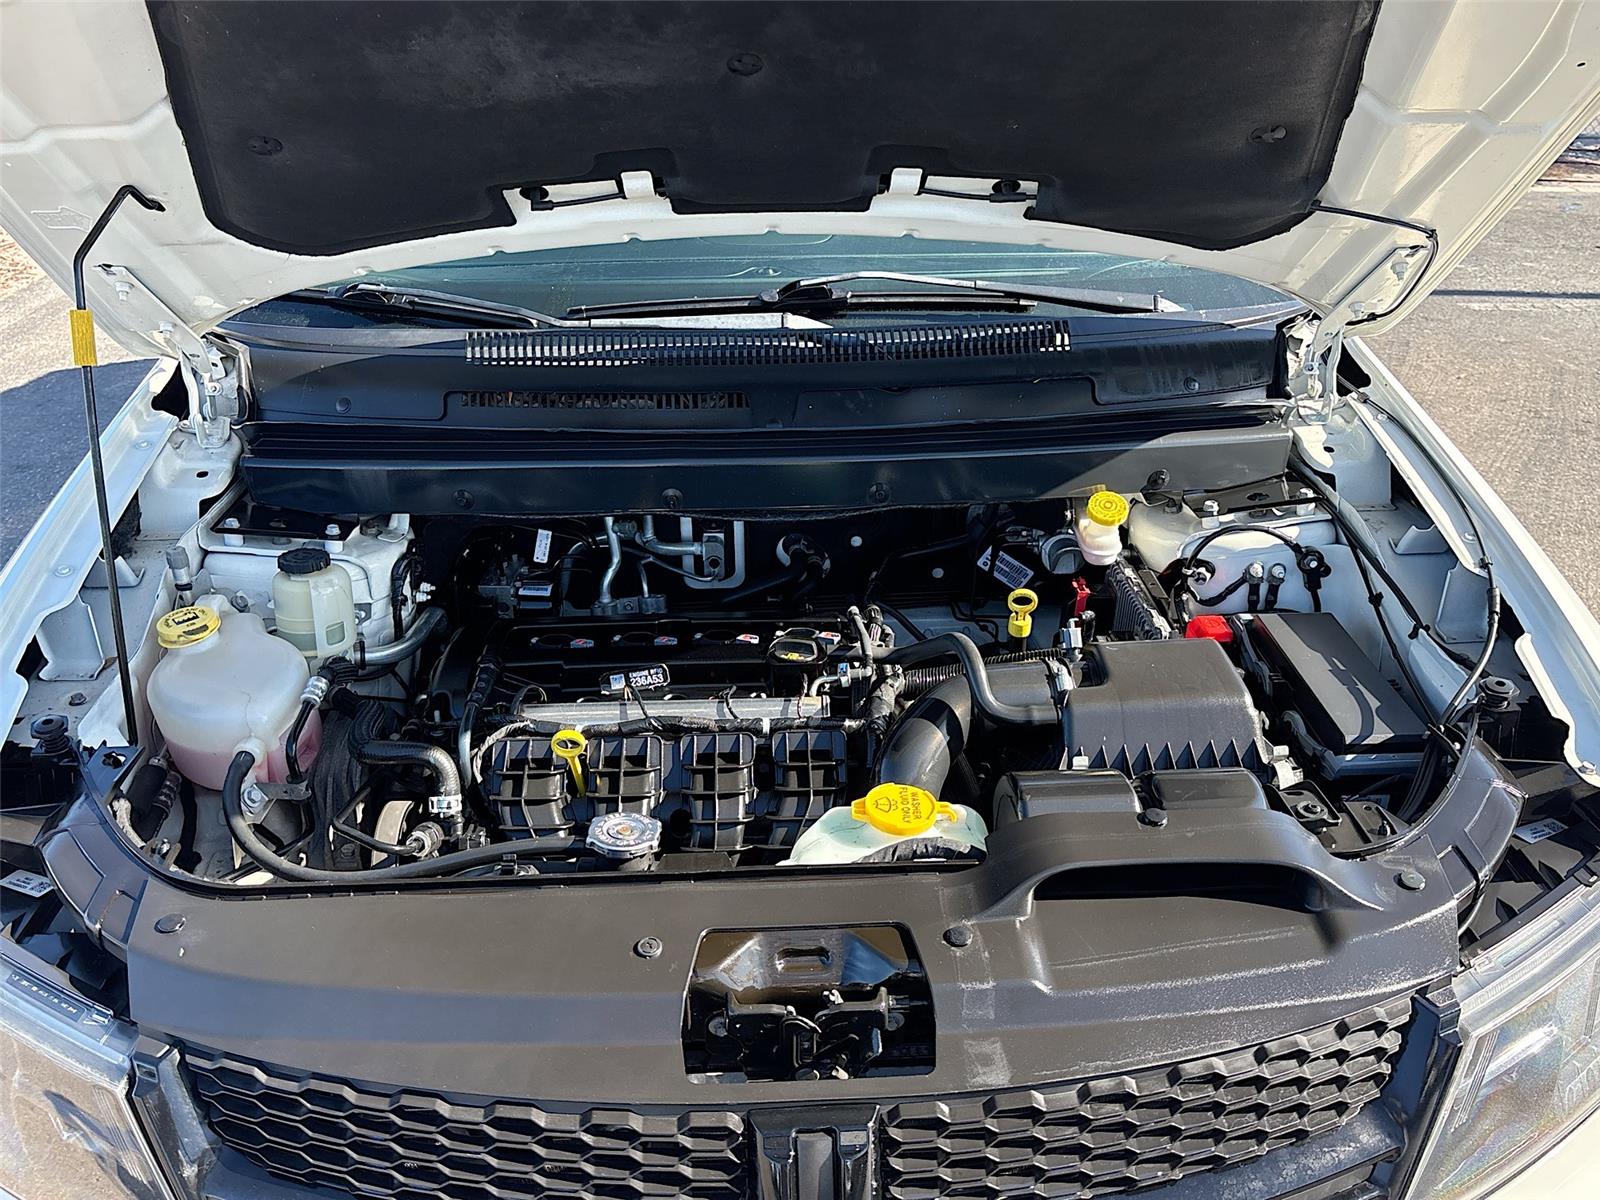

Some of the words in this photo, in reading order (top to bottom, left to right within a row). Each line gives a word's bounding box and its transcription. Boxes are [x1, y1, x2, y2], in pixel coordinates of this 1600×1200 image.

[630, 674, 664, 687] 236A53
[899, 786, 909, 806] FLUID
[910, 791, 922, 820] WASHER
[901, 806, 912, 824] ONLY
